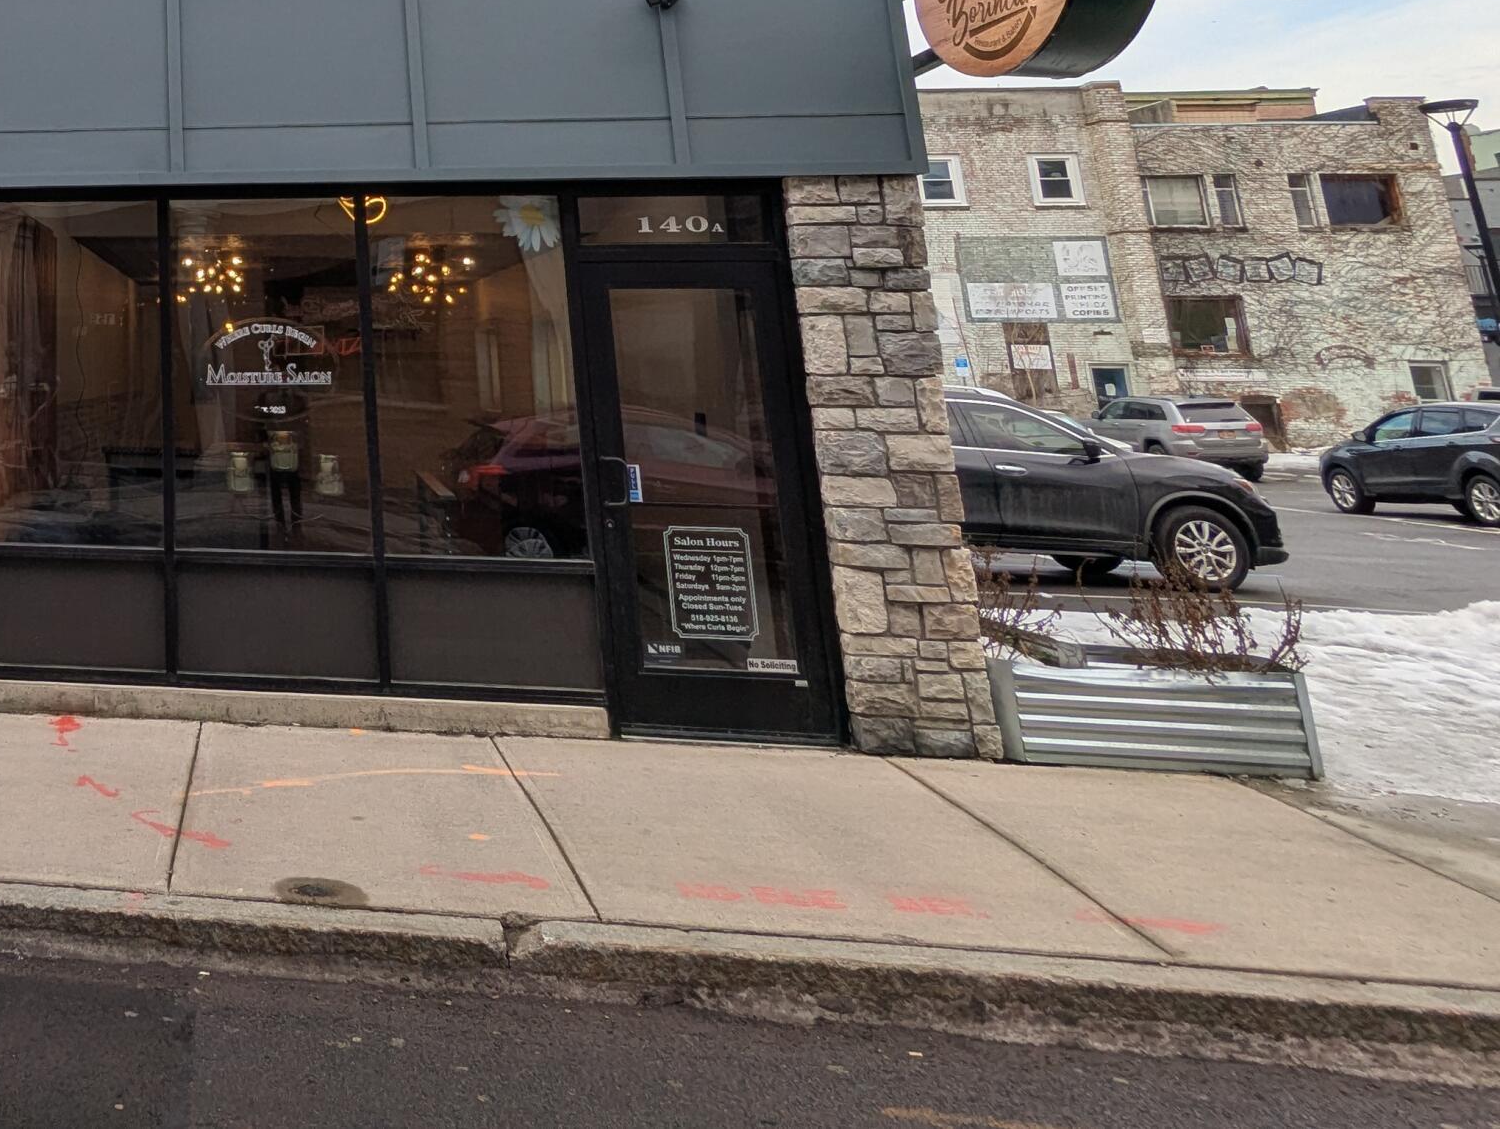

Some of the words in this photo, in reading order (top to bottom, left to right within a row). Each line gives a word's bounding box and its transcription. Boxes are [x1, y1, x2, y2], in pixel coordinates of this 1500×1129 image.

[674, 536, 704, 546] Salon
[706, 538, 740, 547] Hours
[672, 554, 711, 563] Wednesday
[674, 563, 705, 572] Thursday
[675, 572, 696, 581] Friday
[675, 582, 709, 591] Saturdays
[678, 593, 729, 602] Appointments
[730, 596, 747, 604] only
[682, 602, 707, 610] Closed
[707, 623, 726, 631] Curls
[749, 660, 759, 668] No
[760, 661, 797, 672] Soliciting
